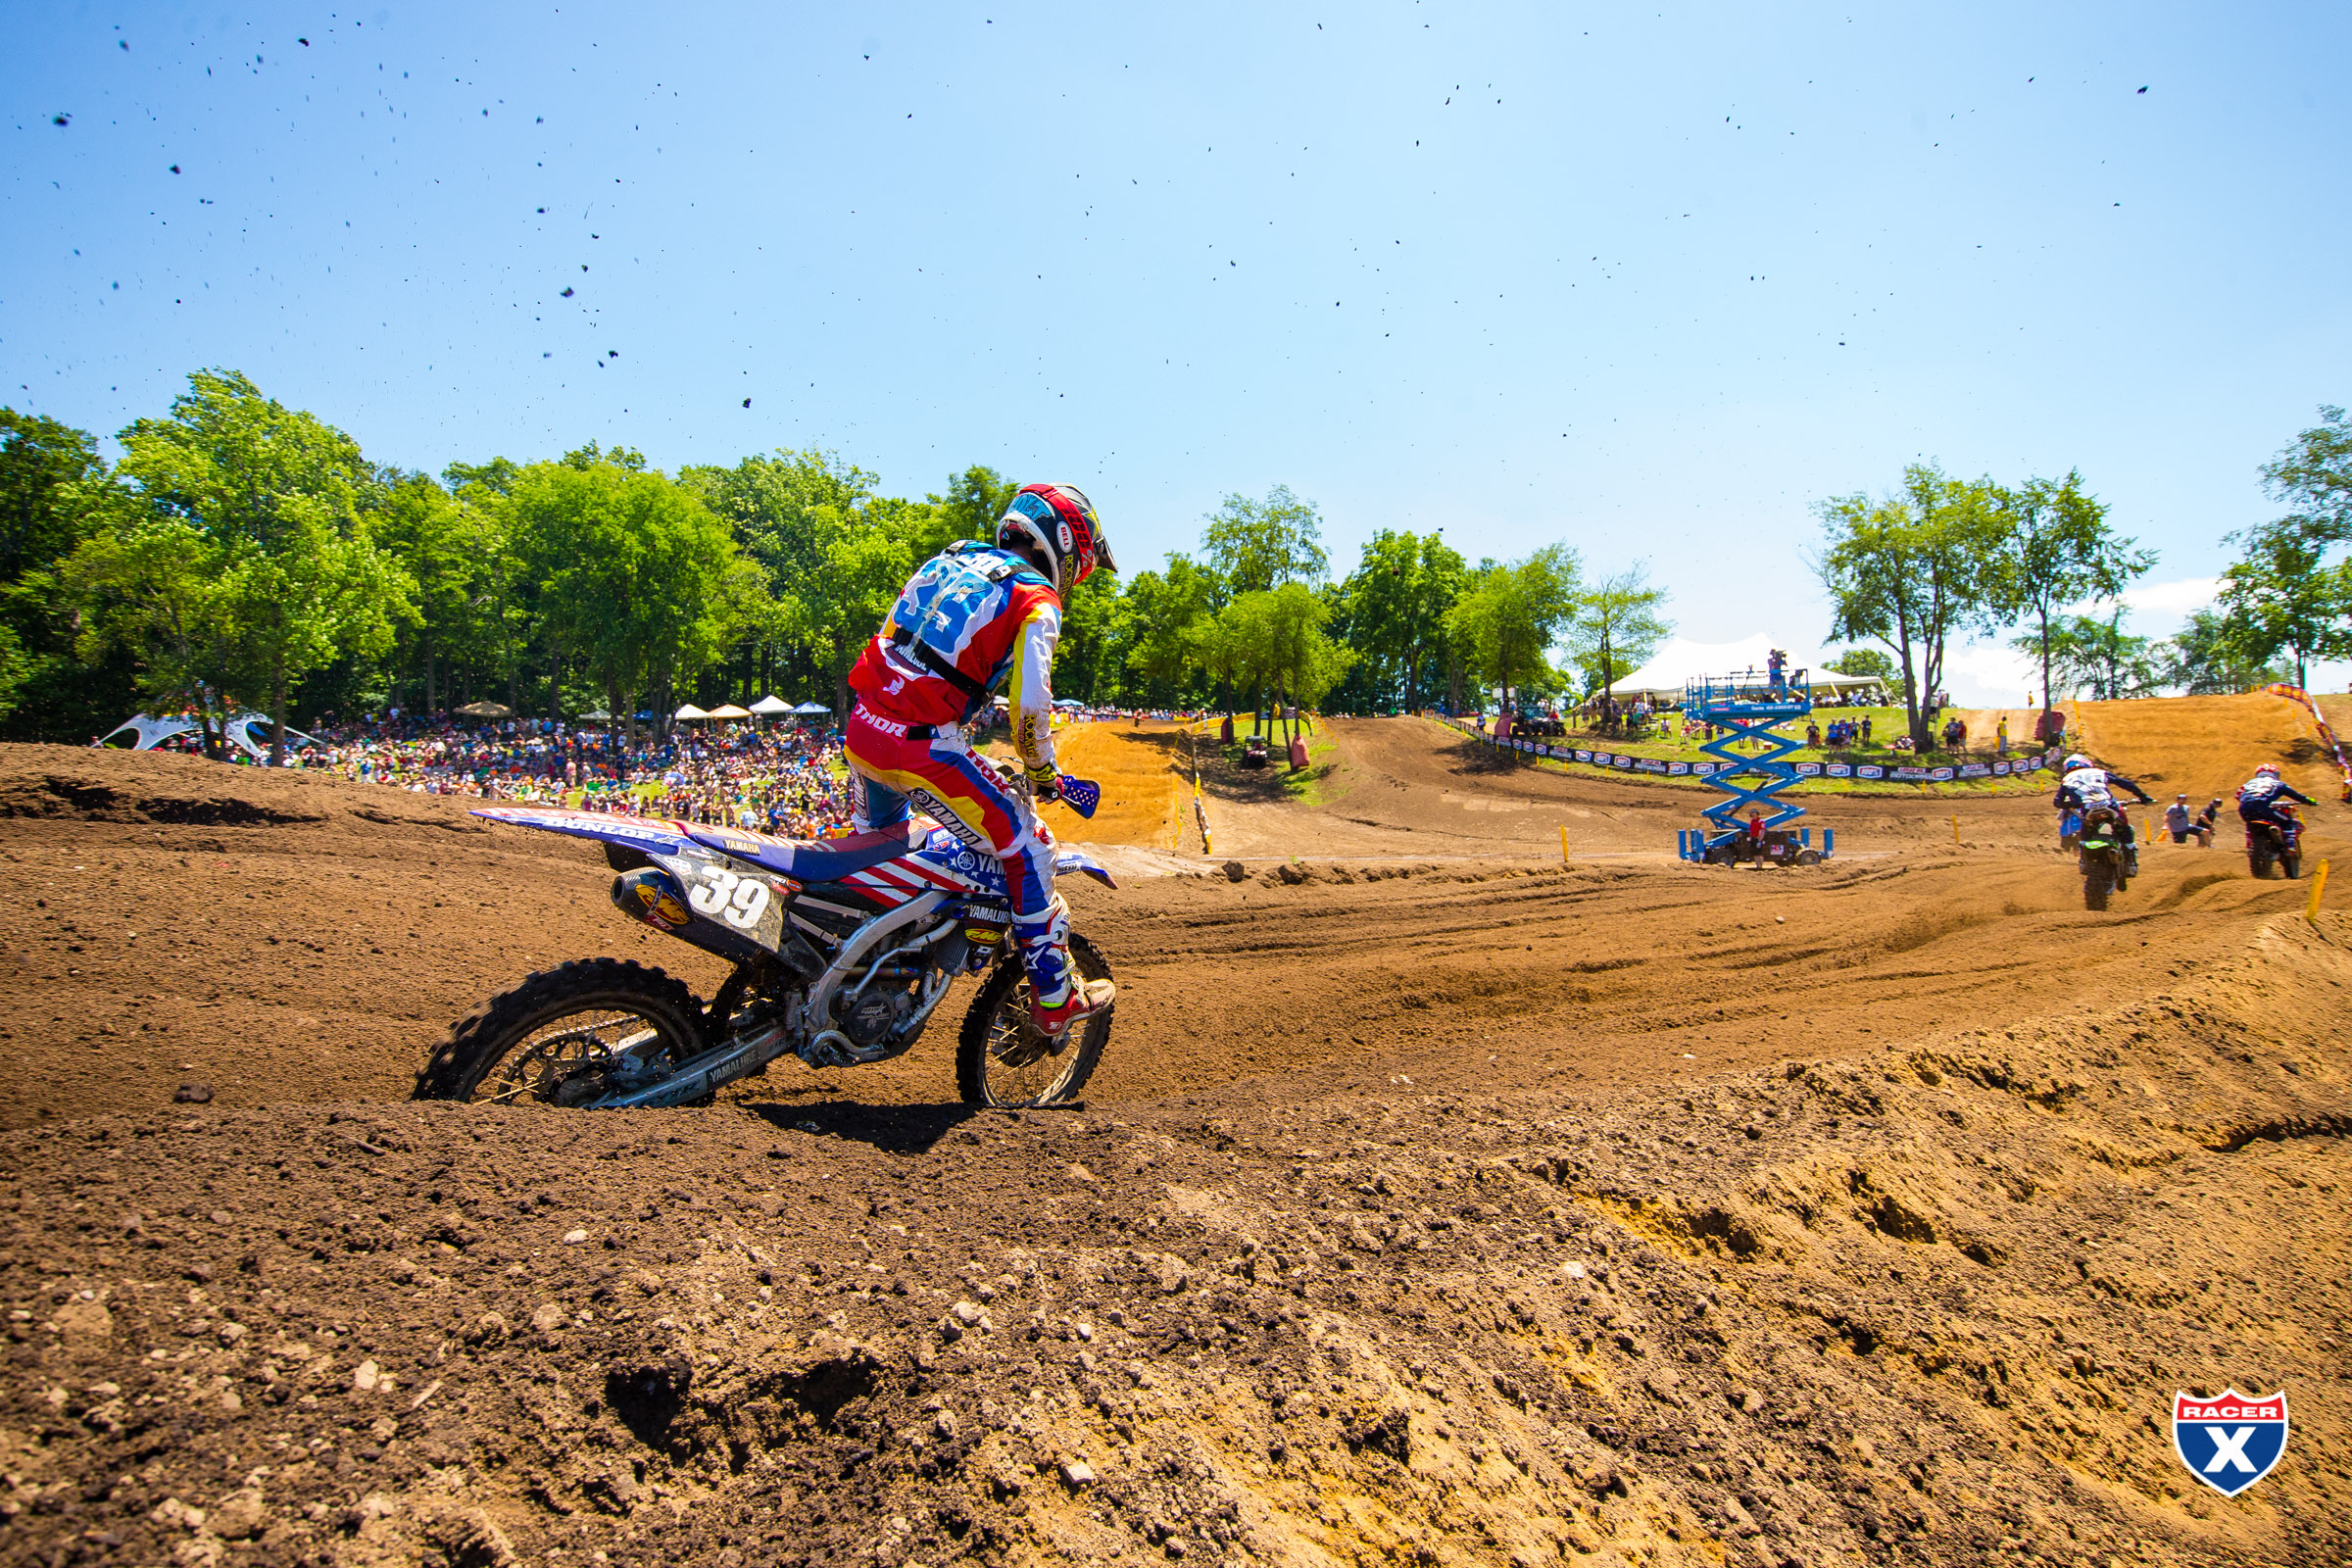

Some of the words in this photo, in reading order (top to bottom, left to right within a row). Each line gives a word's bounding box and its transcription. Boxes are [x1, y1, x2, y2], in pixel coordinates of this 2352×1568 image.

[1059, 526, 1071, 548] BELL
[855, 703, 906, 738] THOR
[965, 745, 1009, 795] THOR
[544, 818, 656, 840] DUNLOP
[925, 800, 981, 847] YAMAHA
[724, 839, 760, 856] YAMAHA
[688, 865, 770, 929] 39
[969, 904, 1012, 923] YAMALUB
[965, 929, 1004, 943] FMF
